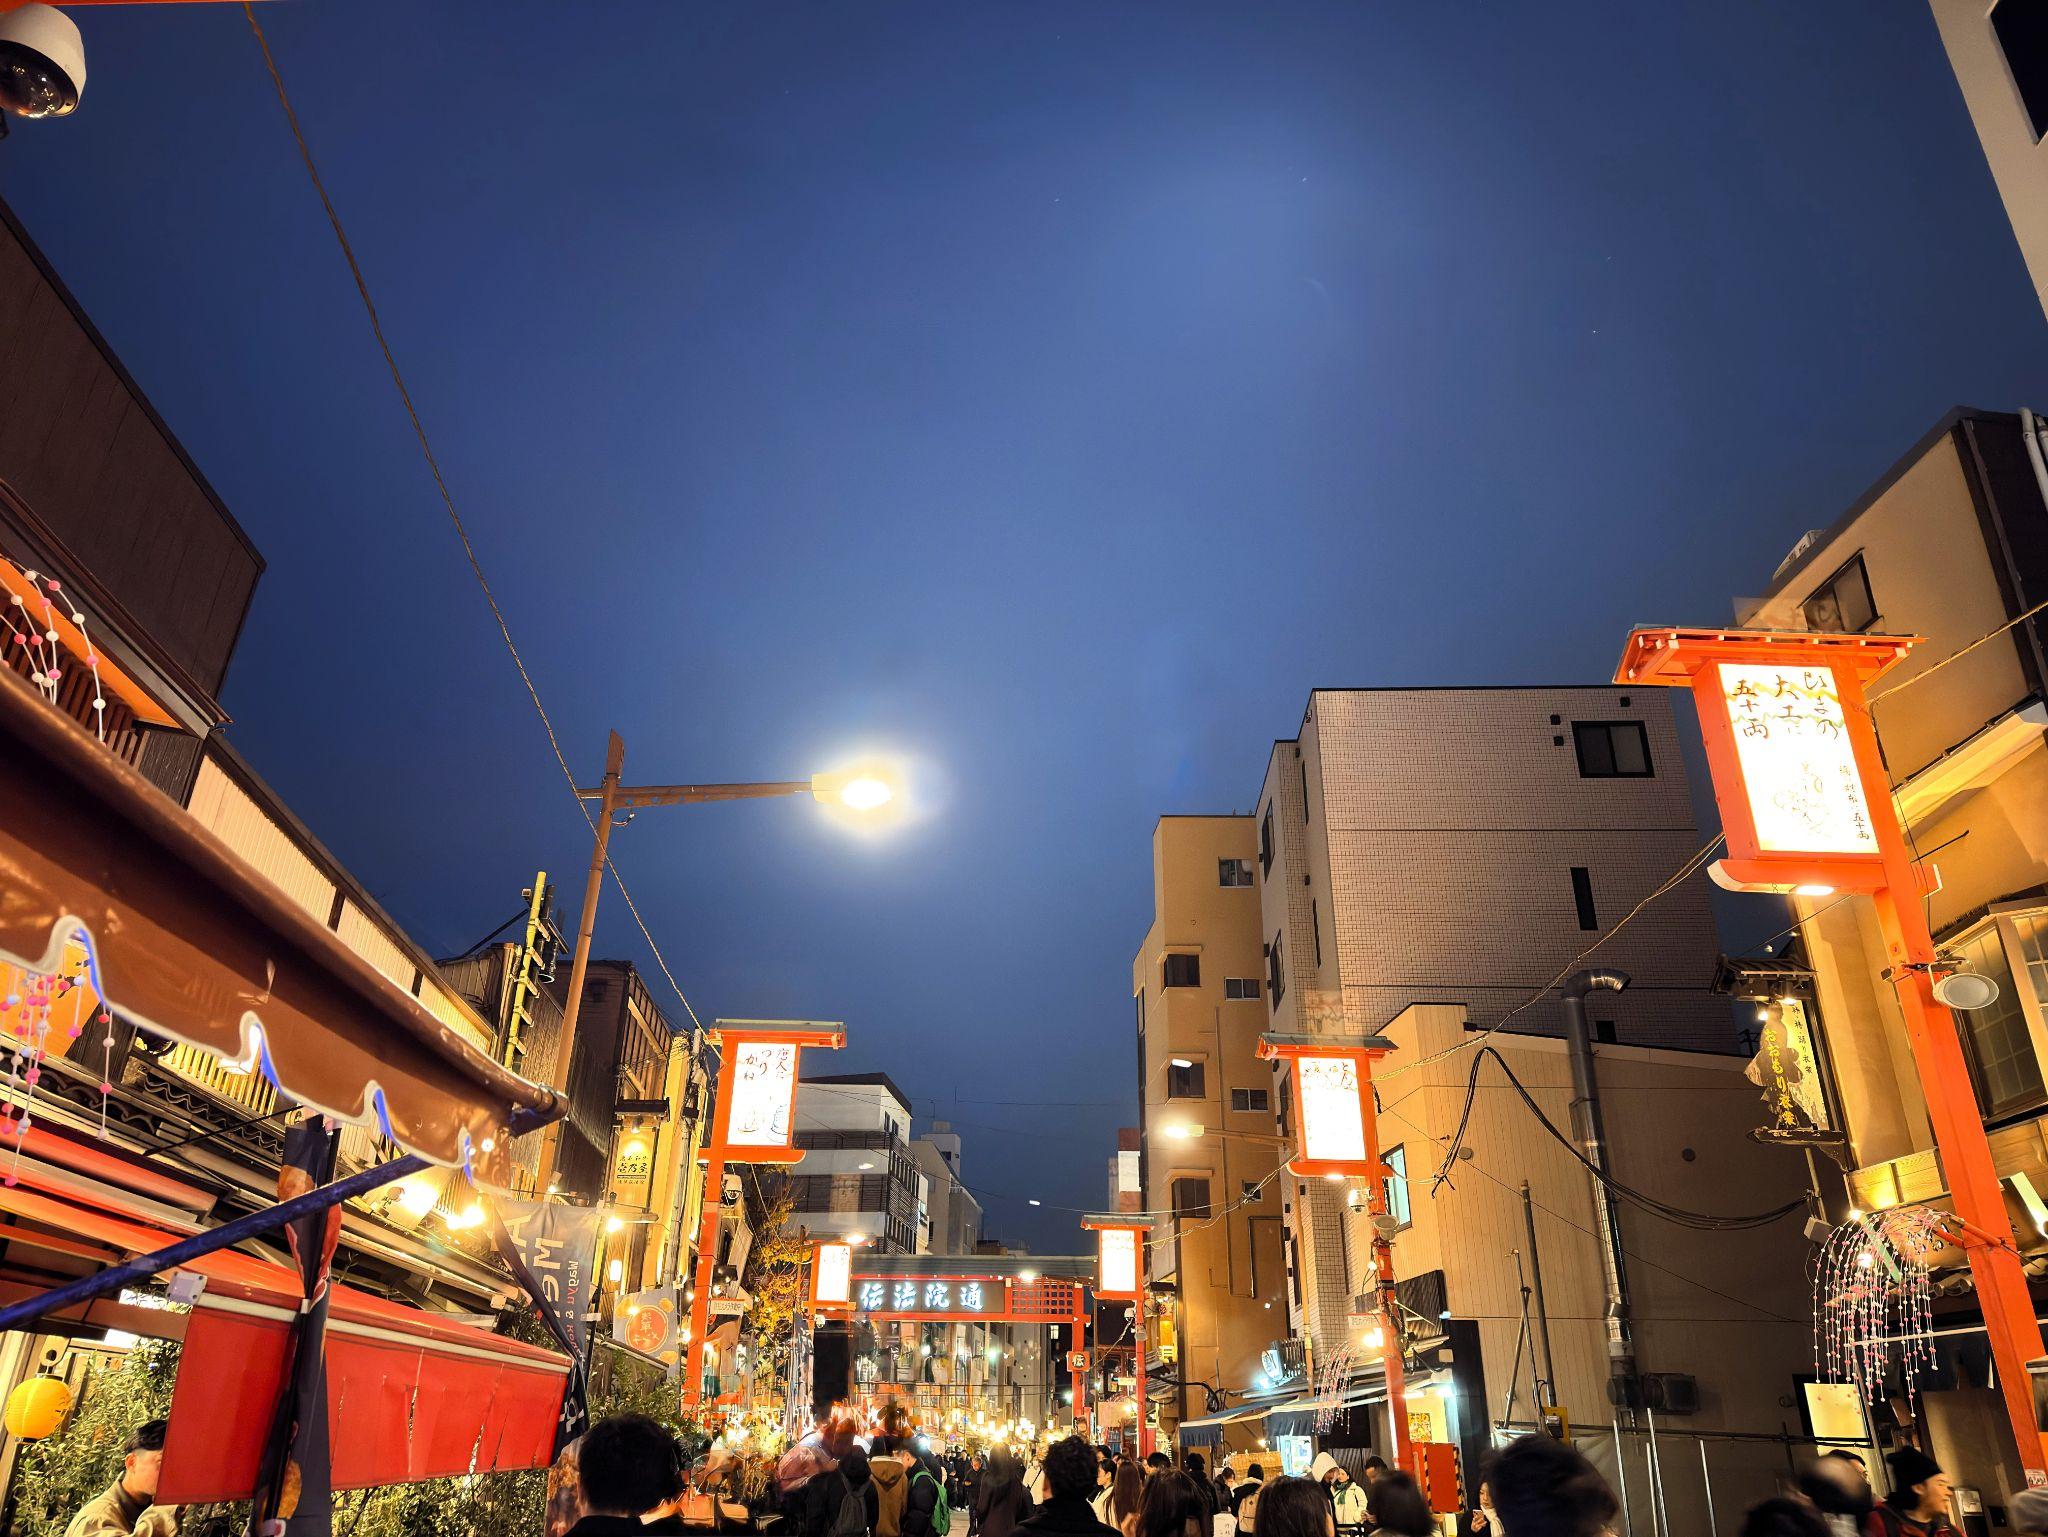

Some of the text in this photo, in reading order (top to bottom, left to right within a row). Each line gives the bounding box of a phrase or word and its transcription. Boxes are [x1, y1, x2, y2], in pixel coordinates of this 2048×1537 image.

[1732, 679, 1769, 739] 五十両
[861, 1281, 983, 1312] 伝法院通
